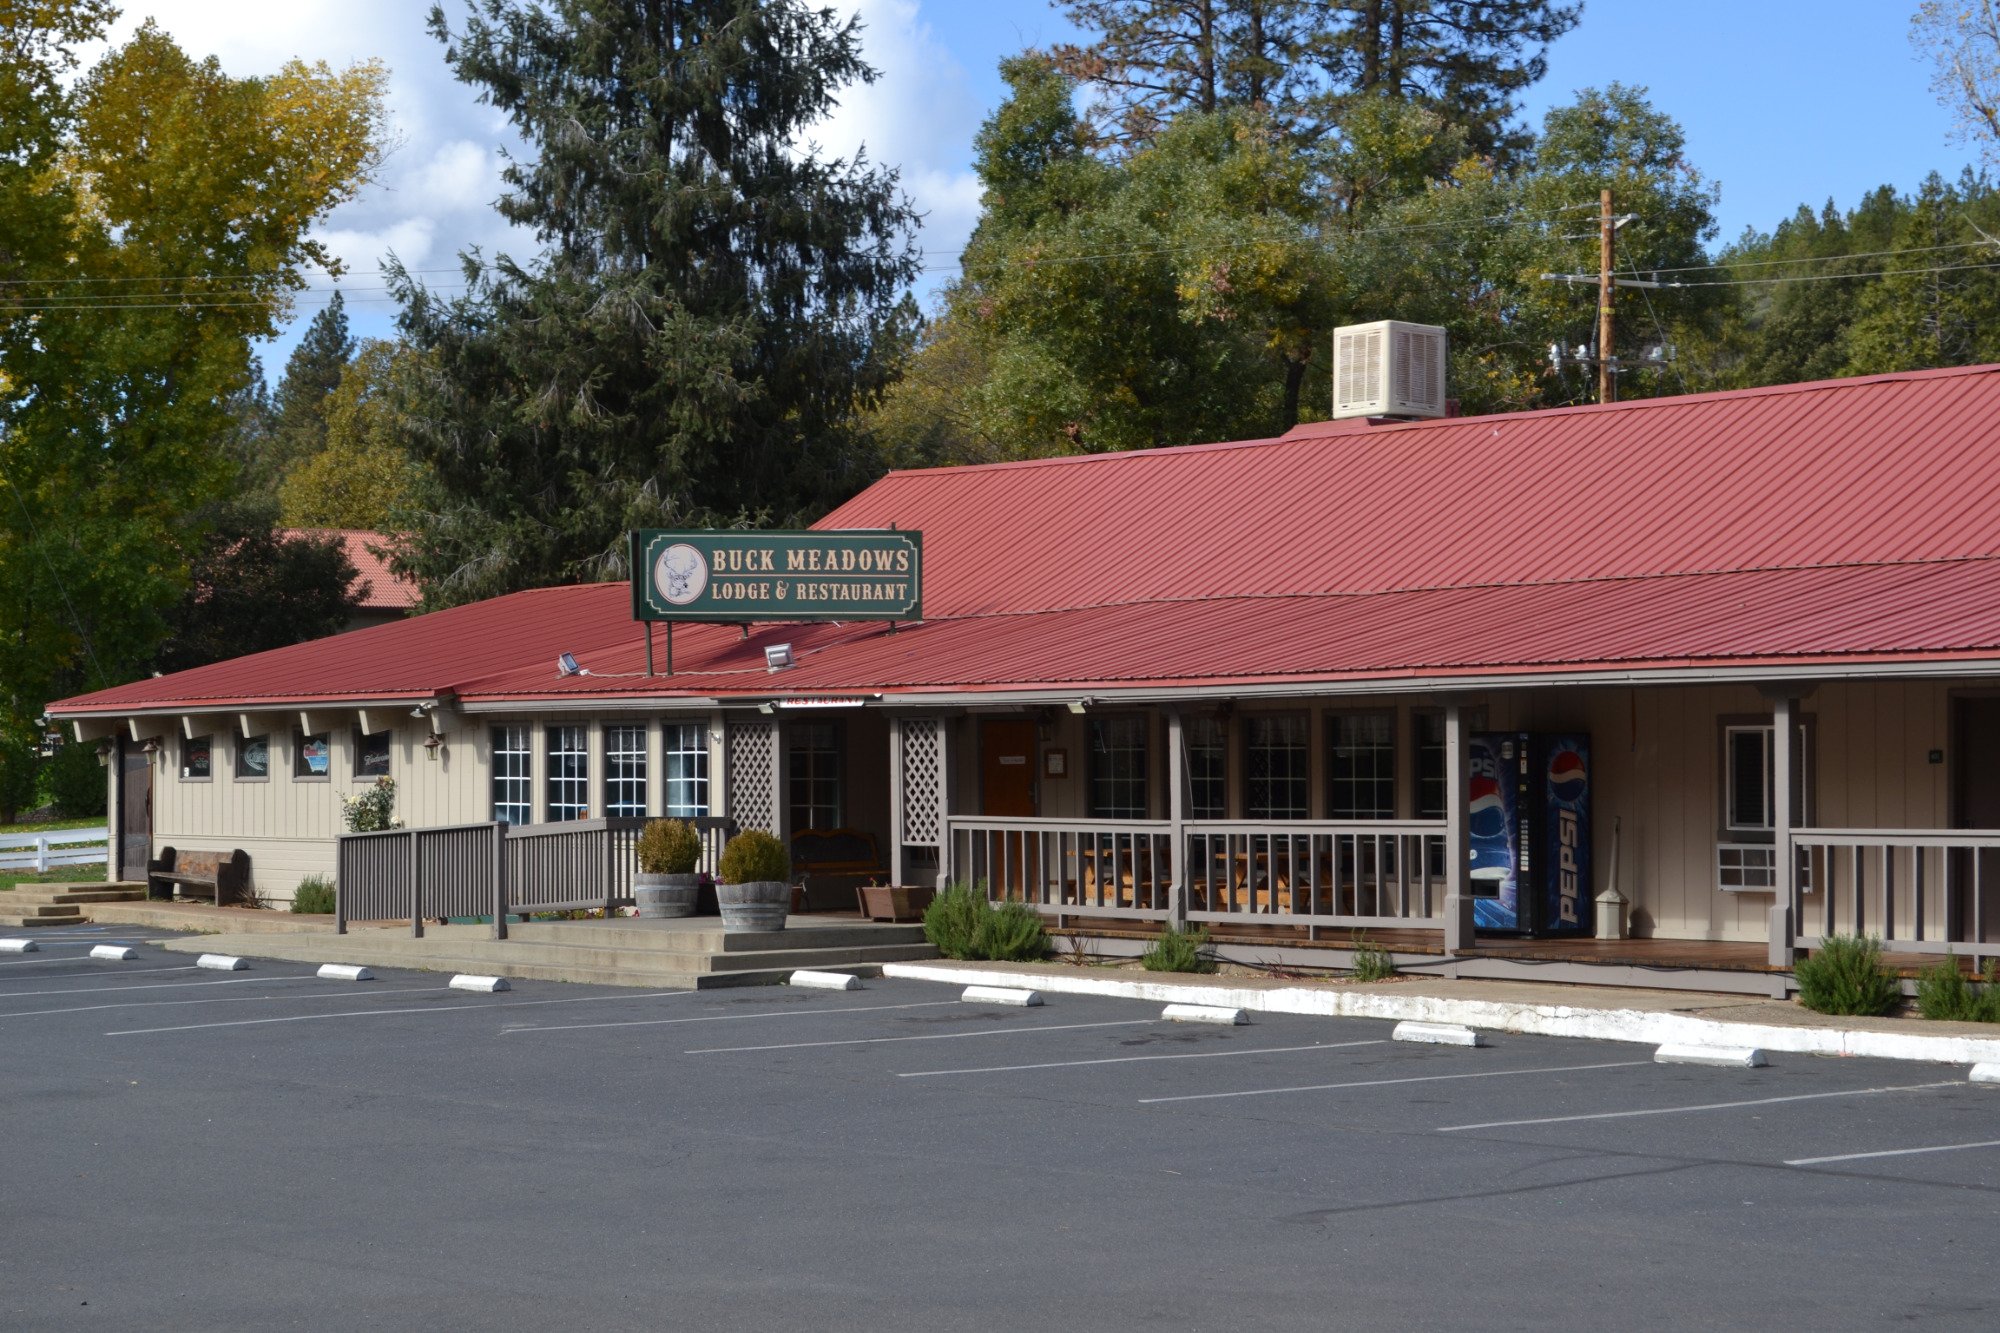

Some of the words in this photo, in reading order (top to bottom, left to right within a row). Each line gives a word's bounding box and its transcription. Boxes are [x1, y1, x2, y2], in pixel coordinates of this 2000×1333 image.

[712, 549, 775, 571] BUCK
[786, 549, 910, 571] MEADOWS
[712, 582, 770, 600] LODGE
[775, 580, 789, 600] &
[796, 582, 908, 600] RESTAURANT
[1470, 757, 1498, 780] PSI
[1559, 809, 1579, 924] PEPSI
